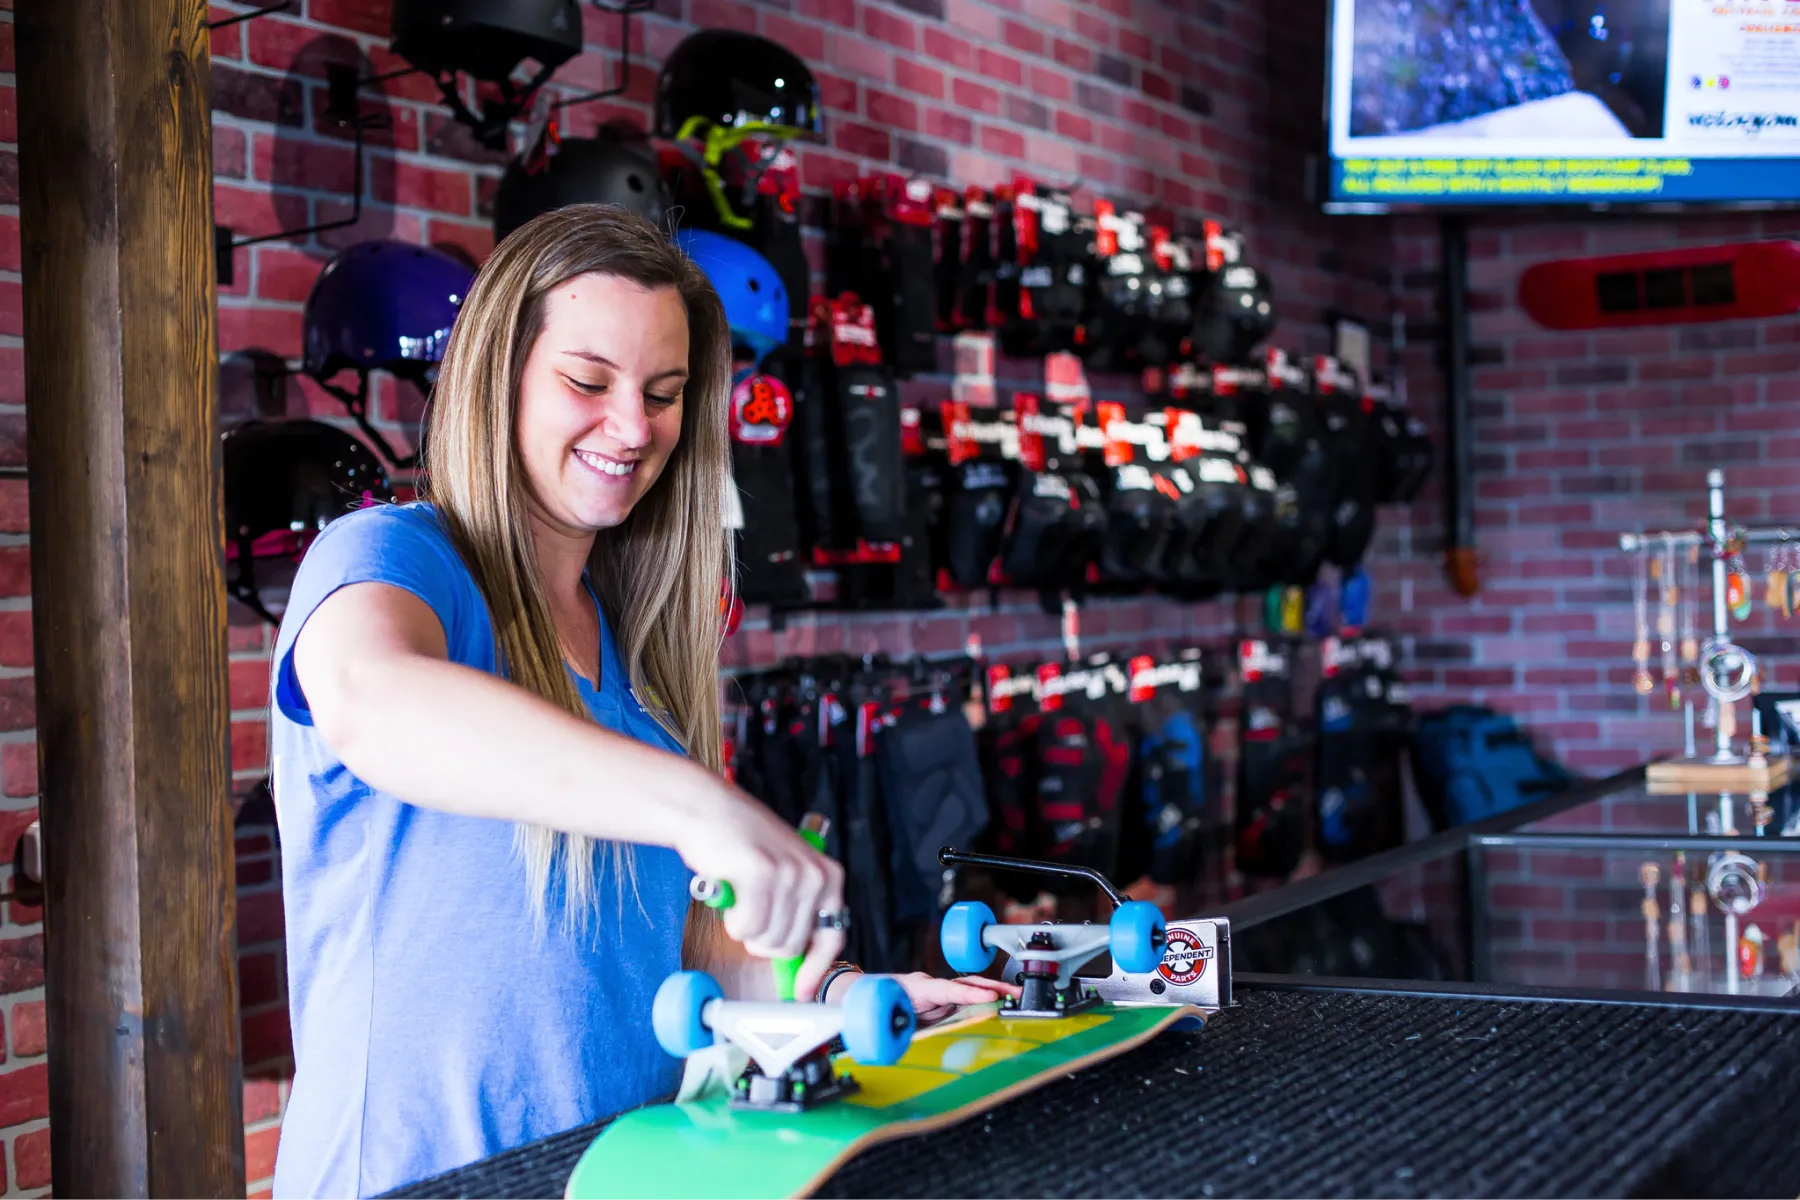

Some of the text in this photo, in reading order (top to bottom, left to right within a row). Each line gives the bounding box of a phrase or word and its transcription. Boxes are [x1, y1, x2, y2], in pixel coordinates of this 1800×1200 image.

[1167, 933, 1195, 945] NUINE
[1164, 950, 1210, 962] EPENDENT
[1170, 971, 1197, 982] PARTS
